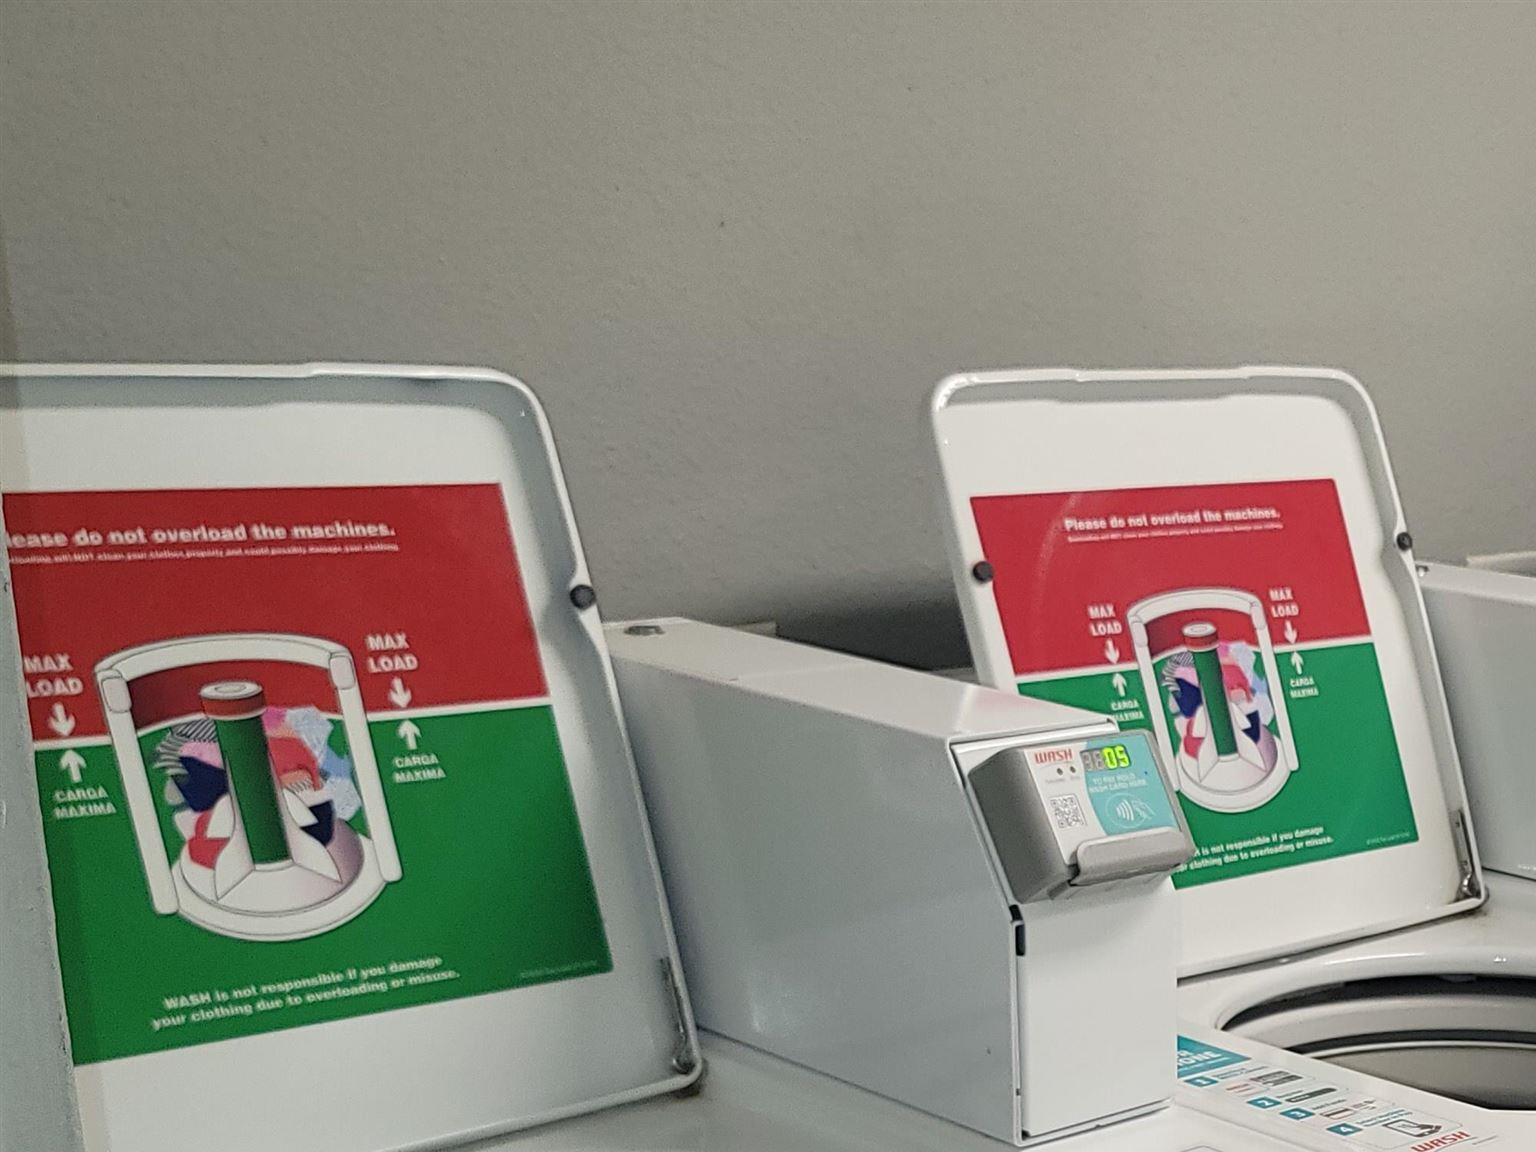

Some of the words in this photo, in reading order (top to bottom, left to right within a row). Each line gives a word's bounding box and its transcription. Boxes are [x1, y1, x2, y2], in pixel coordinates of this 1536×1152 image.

[1065, 516, 1107, 532] Please
[1109, 514, 1126, 529] do
[1128, 514, 1148, 528] not
[1151, 509, 1201, 527] overload
[1203, 509, 1223, 522] the
[1224, 506, 1281, 522] machines.
[7, 531, 69, 548] lease
[72, 526, 104, 546] do
[107, 526, 148, 545] not
[151, 524, 248, 544] overload
[252, 522, 287, 541] the
[292, 520, 396, 540] machines.
[1269, 588, 1293, 601] MAX
[1087, 604, 1116, 618] MAX
[1270, 604, 1299, 618] LOAD
[1090, 621, 1122, 637] LOAD
[366, 632, 410, 650] MAX
[24, 652, 74, 673] MAX
[368, 653, 419, 674] LOAD
[26, 677, 84, 698] LOAD
[1289, 677, 1315, 687] CARGA
[1111, 699, 1140, 711] CARGA
[392, 753, 439, 768] CARGA
[1034, 748, 1074, 765] WASH
[1102, 745, 1130, 769] 05
[54, 785, 109, 802] CARGA
[53, 802, 118, 820] MAXIMA
[1202, 848, 1210, 857] is
[1211, 845, 1225, 854] not
[1226, 836, 1270, 852] responsible
[1272, 834, 1278, 842] if
[1279, 831, 1294, 843] you
[1294, 826, 1324, 839] damage
[1190, 856, 1222, 871] clothing
[1224, 853, 1239, 864] due
[1240, 851, 1249, 860] to
[1250, 843, 1295, 859] overloading
[1296, 841, 1305, 850] or
[162, 990, 212, 1011] WASH
[214, 990, 230, 1002] is
[232, 985, 257, 999] not
[260, 969, 344, 998] responsible
[346, 967, 357, 981] if
[359, 964, 387, 981] you
[389, 955, 443, 978] damage
[151, 1013, 187, 1032] your
[190, 1003, 254, 1024] clothing
[256, 997, 284, 1013] due
[286, 992, 303, 1007] to
[305, 980, 388, 1006] overloading
[390, 976, 406, 989] or
[407, 968, 461, 986] misuse.
[1411, 1131, 1472, 1152] WASH
